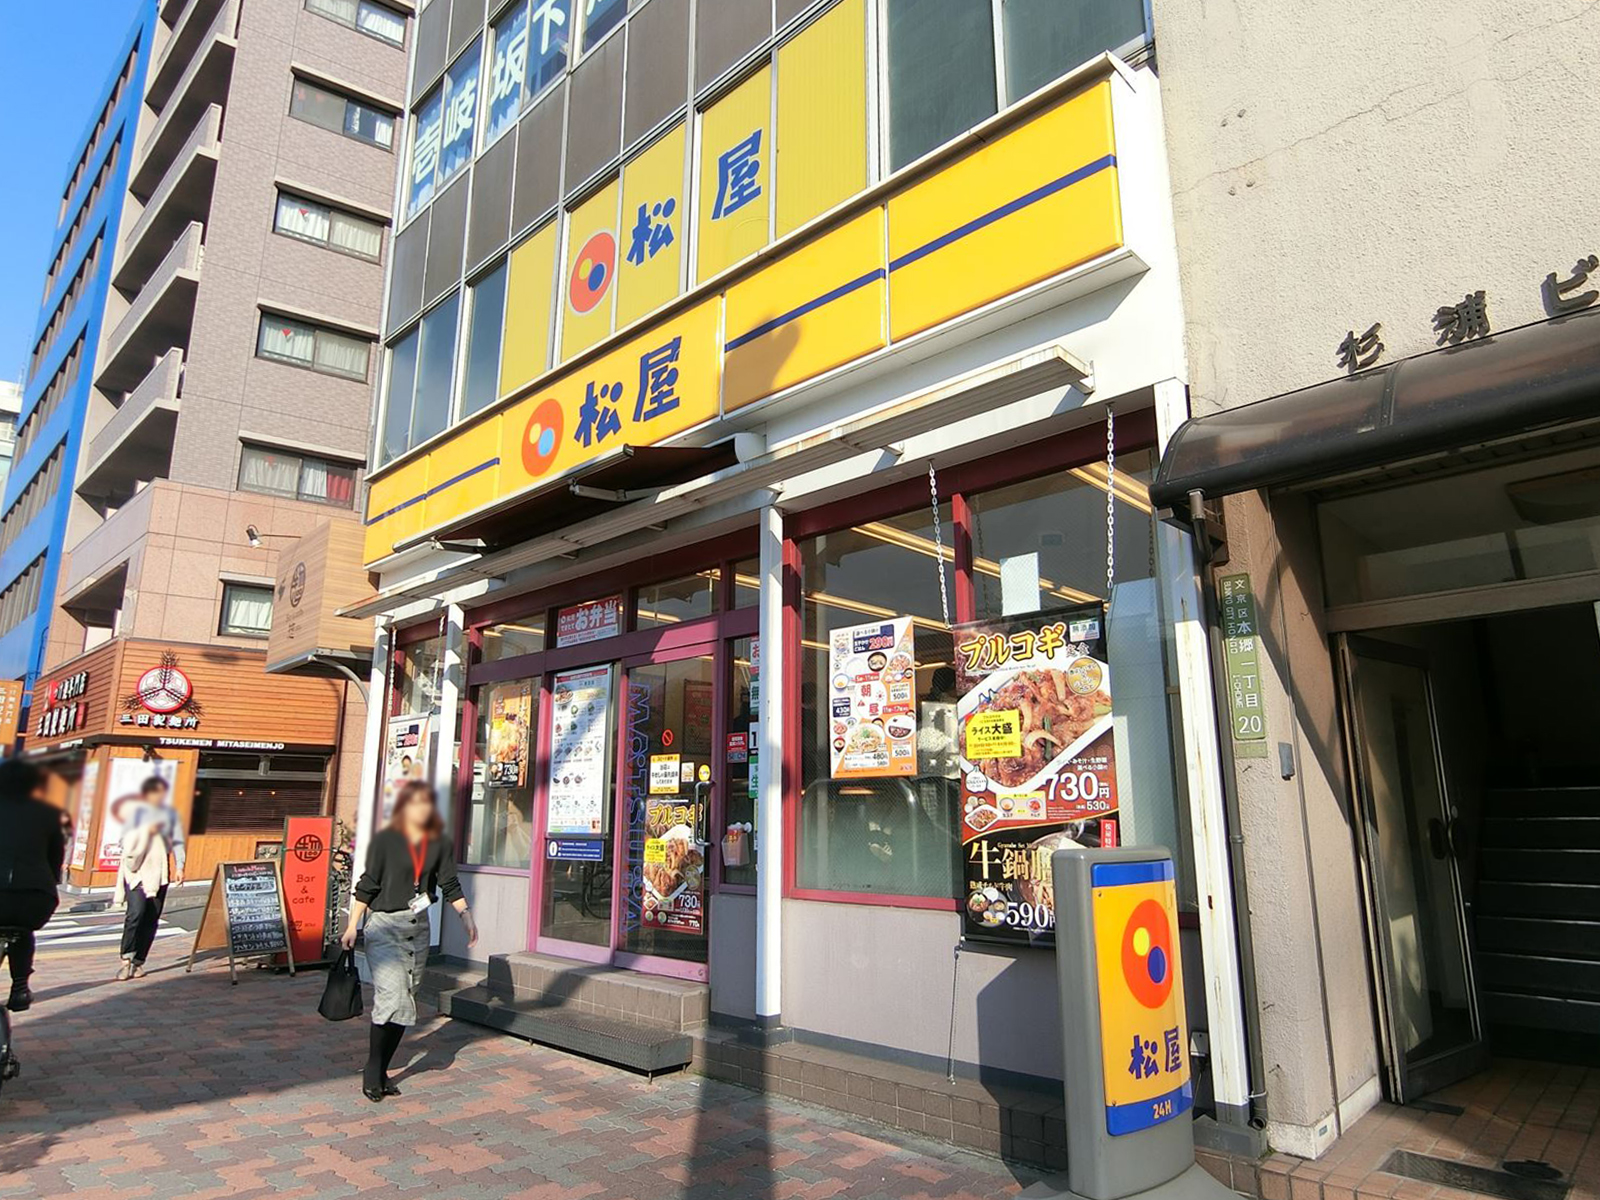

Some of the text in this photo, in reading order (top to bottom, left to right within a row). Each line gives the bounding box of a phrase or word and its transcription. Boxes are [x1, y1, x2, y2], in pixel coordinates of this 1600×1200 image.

[411, 0, 602, 185] 壱岐坂下
[626, 128, 763, 267] 松屋
[1335, 254, 1599, 375] 杉浦ビ
[573, 335, 683, 448] 松屋
[574, 599, 617, 632] お弁当
[1226, 606, 1236, 621] CITY
[960, 622, 1067, 671] プルコギ
[1227, 622, 1240, 655] HONGO
[861, 684, 872, 697] 朝
[869, 703, 880, 716] 昼
[971, 722, 1013, 736] ライス大盛
[1238, 715, 1263, 735] 20
[159, 737, 285, 751] TSUKEMEN MITASEIMENJO
[649, 804, 704, 826] プルコギ
[296, 874, 316, 884] Bar
[292, 896, 316, 905] cafe
[1128, 1025, 1183, 1080] 松屋
[1152, 1099, 1172, 1121] 24H
